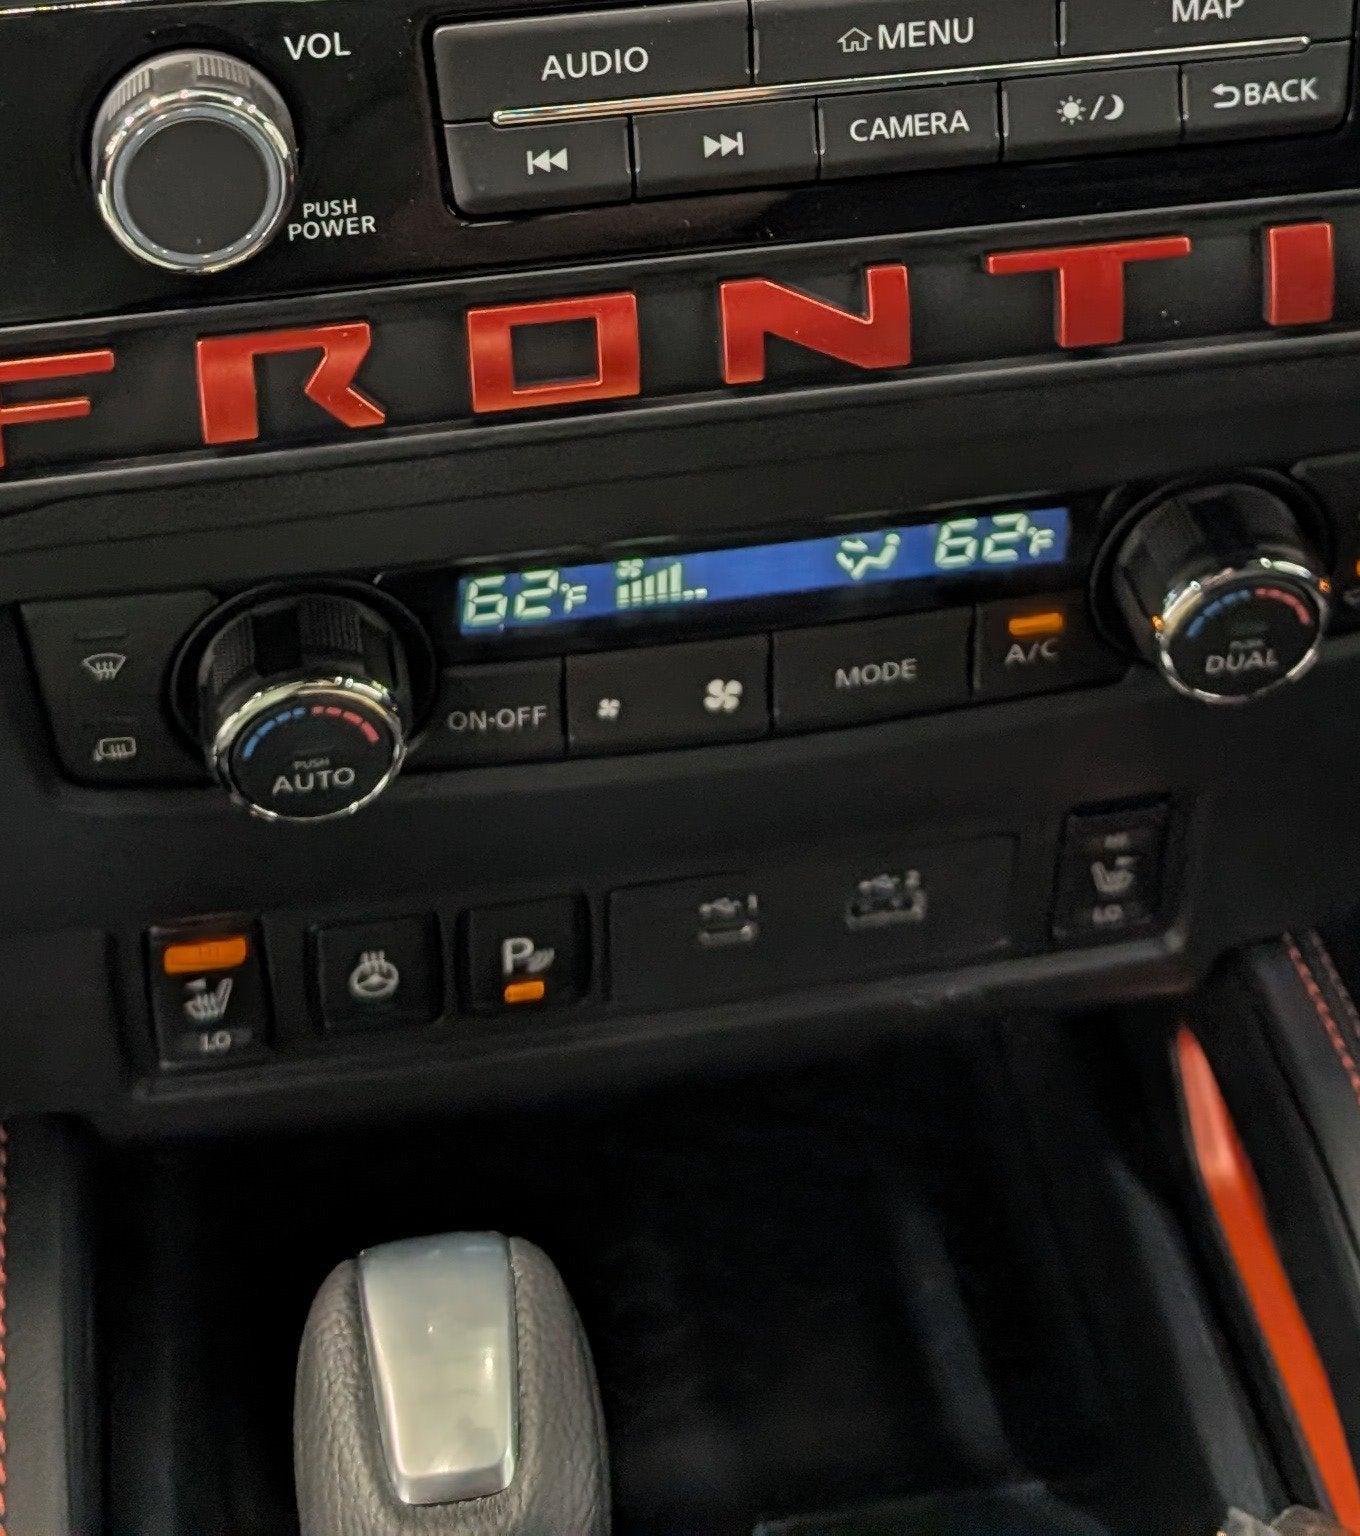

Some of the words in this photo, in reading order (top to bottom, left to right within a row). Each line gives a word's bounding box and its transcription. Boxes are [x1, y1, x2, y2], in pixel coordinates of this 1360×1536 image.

[283, 32, 351, 62] VOL
[877, 16, 976, 51] MENU
[541, 47, 649, 81] AUDIO
[1243, 77, 1319, 106] BACK
[849, 108, 970, 142] CAMERA
[302, 198, 358, 217] PUSH
[288, 214, 377, 242] POWER
[1004, 638, 1059, 664] A/C
[1205, 648, 1280, 675] DUAL
[835, 657, 918, 689] MODE
[271, 766, 356, 797] AUTO
[200, 1030, 232, 1053] LO
